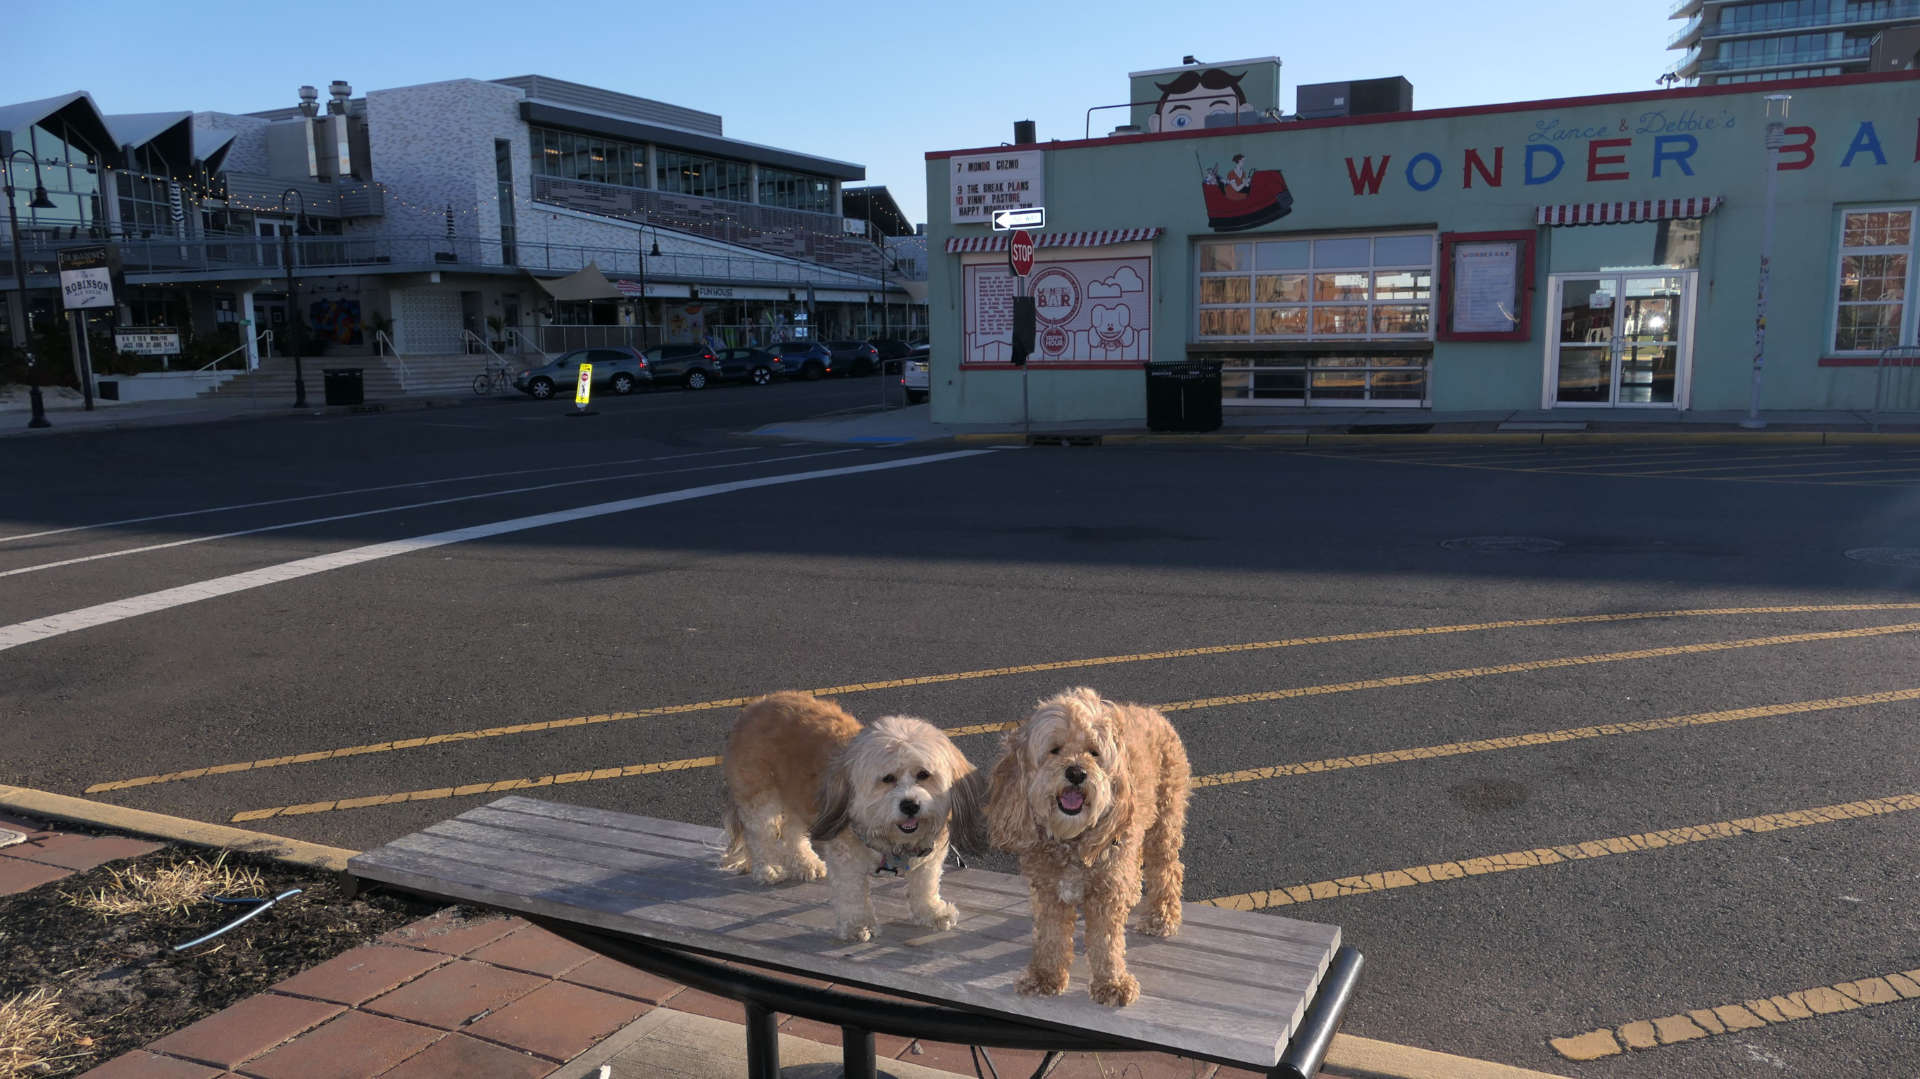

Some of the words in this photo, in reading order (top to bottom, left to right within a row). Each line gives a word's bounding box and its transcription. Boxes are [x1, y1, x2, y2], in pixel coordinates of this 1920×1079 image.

[1528, 119, 1611, 143] Lance
[1618, 118, 1629, 132] &
[1635, 109, 1736, 135] Debbie's
[1344, 133, 1699, 195] WONDER
[1776, 117, 1920, 171] BA
[957, 163, 962, 173] 7
[967, 161, 990, 172] MONDO
[967, 184, 979, 194] THE
[983, 183, 1004, 193] BREAK
[1007, 181, 1029, 192] PLANS
[967, 195, 986, 205] VINNY
[959, 206, 979, 216] HAPPY
[1013, 243, 1033, 262] STOP
[64, 279, 110, 296] ROBINSON
